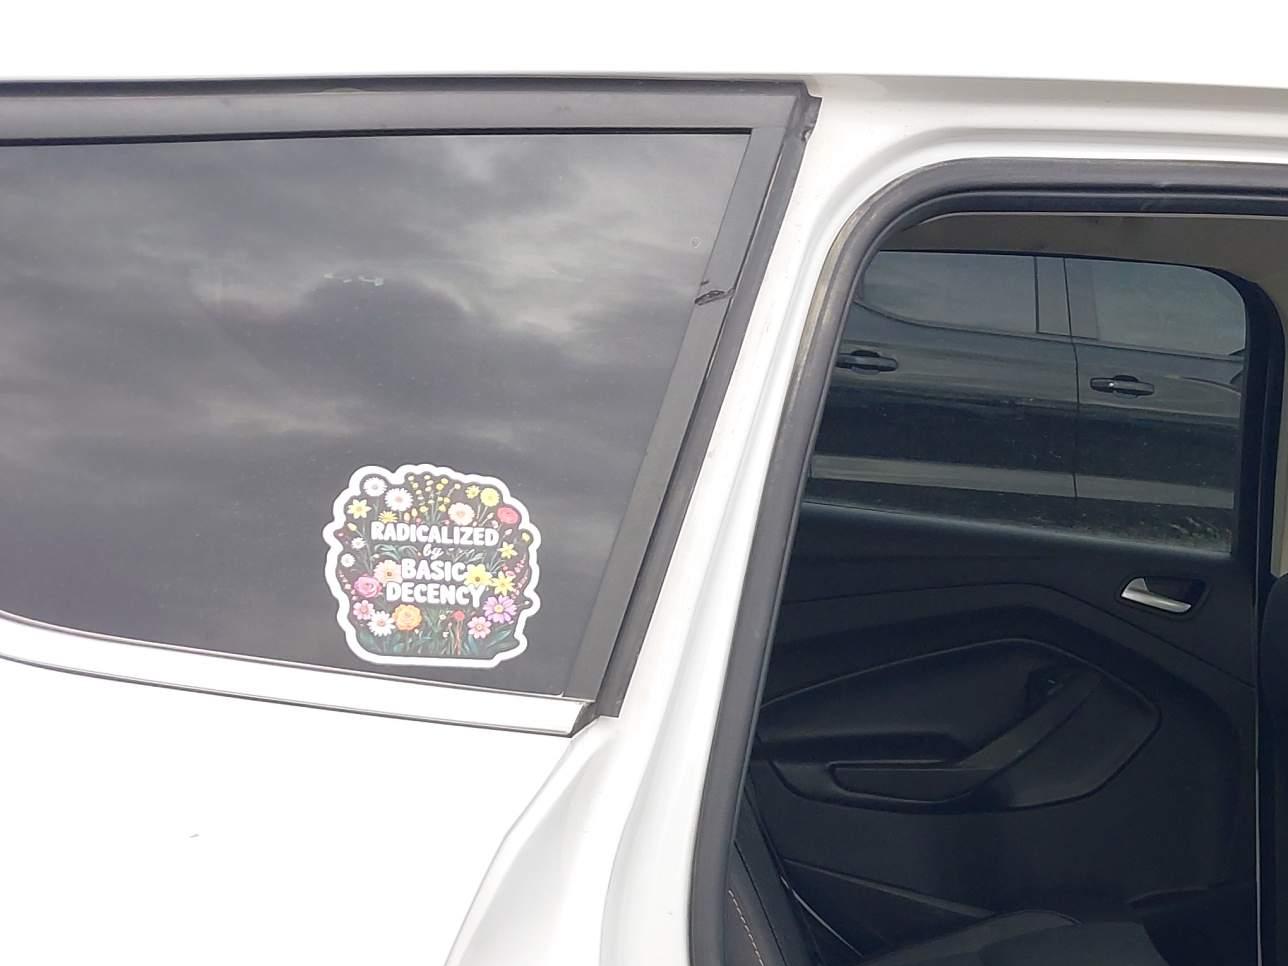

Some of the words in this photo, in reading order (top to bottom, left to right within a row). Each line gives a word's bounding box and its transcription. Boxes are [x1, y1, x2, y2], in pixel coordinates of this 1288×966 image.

[371, 521, 499, 546] RADICALIZED
[422, 543, 444, 560] by
[401, 558, 467, 582] BASIC
[386, 581, 486, 608] DECENCY
